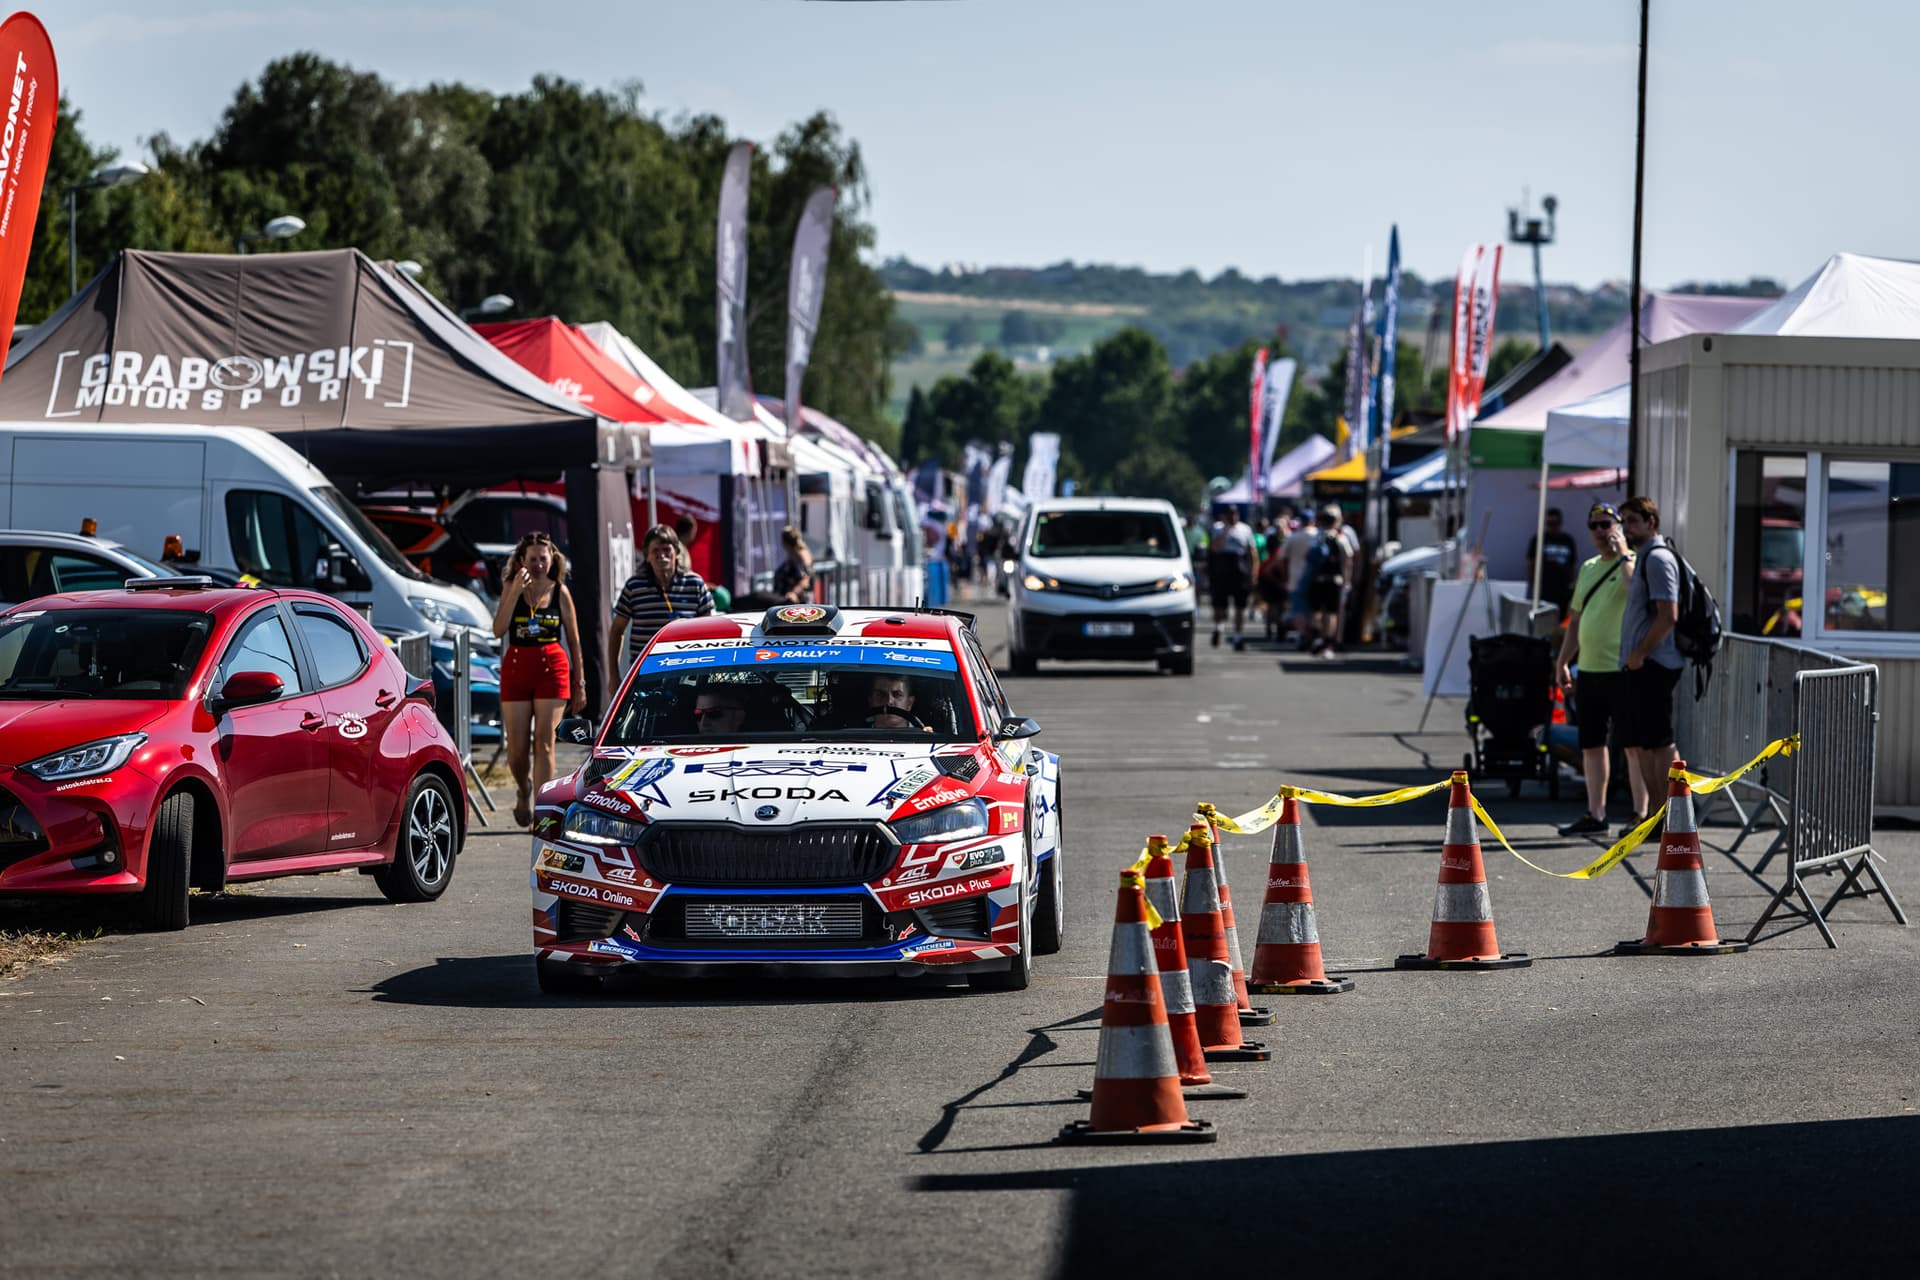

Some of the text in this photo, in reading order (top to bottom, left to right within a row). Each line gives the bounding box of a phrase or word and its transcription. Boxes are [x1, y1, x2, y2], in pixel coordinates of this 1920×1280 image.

[763, 639, 928, 648] MOTORSPORT
[782, 650, 828, 659] RALLY
[583, 791, 633, 814] Emotive
[911, 788, 969, 811] Emotive
[969, 850, 985, 860] EVO
[968, 879, 992, 892] Plus
[602, 889, 633, 906] Online
[600, 944, 634, 955] MICHELIN
[915, 941, 952, 952] MICHELIN
